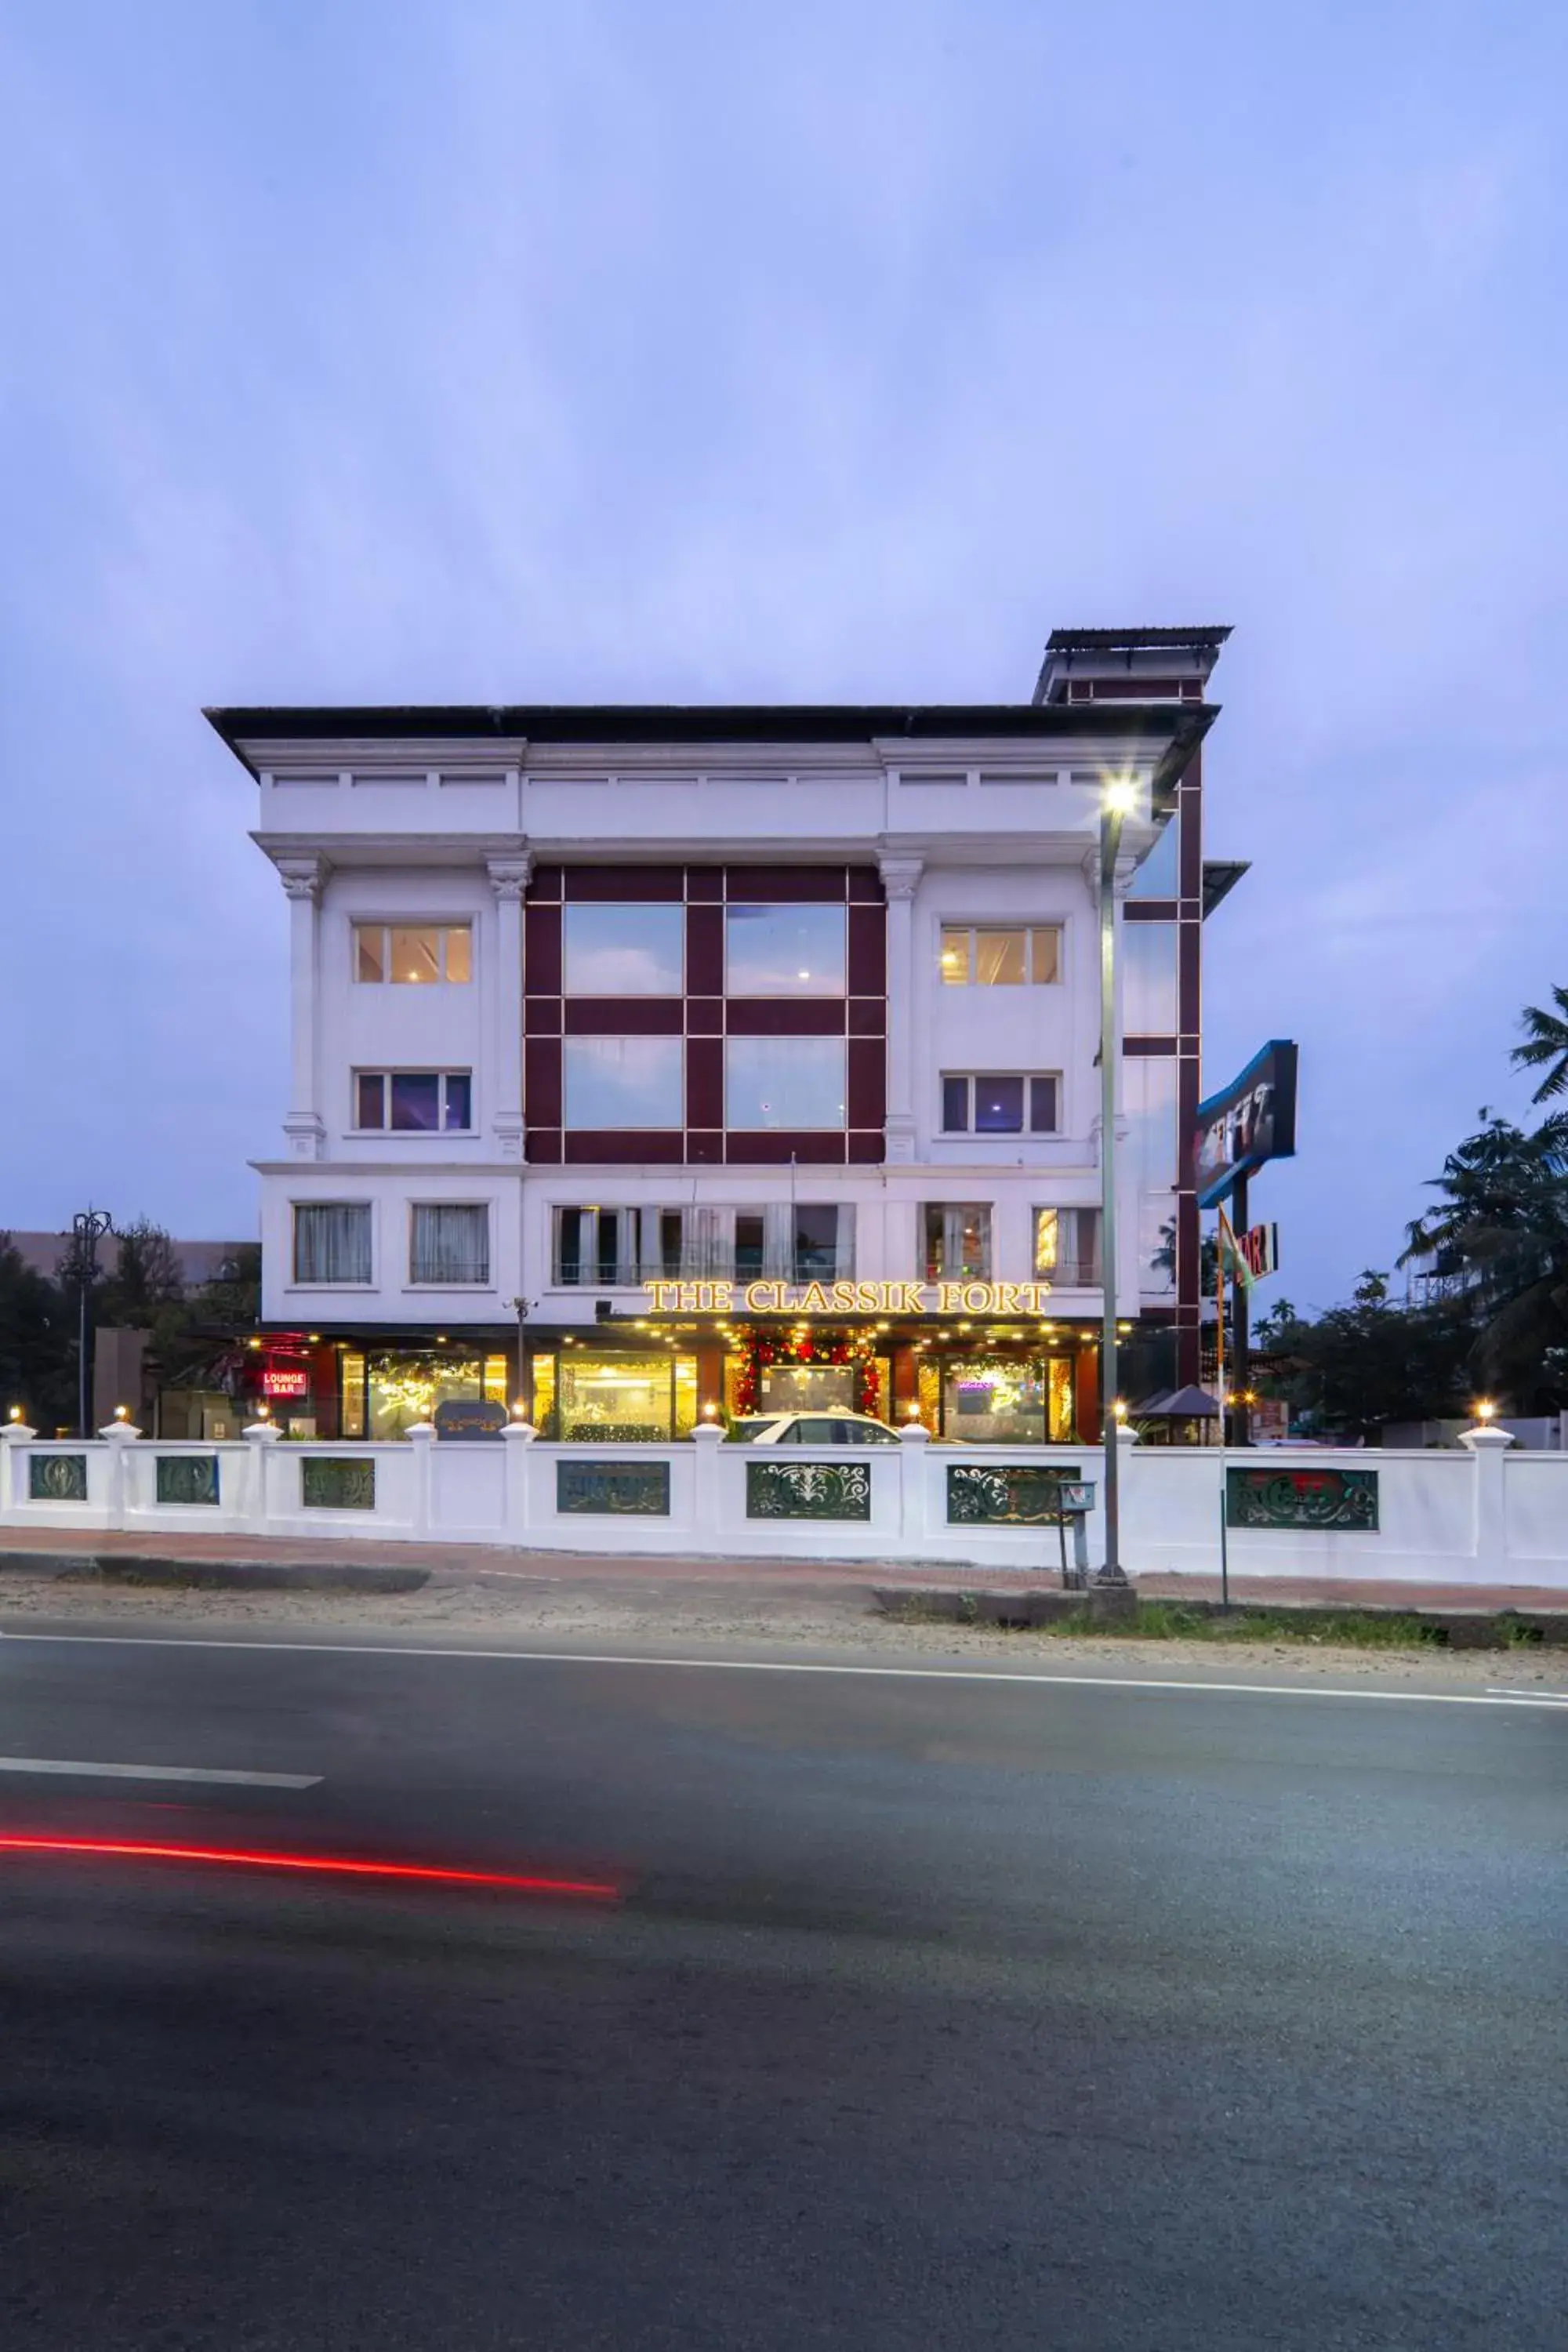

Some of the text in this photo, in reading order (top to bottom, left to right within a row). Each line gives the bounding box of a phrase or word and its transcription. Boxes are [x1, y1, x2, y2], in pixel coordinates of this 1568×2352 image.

[644, 1279, 1051, 1315] THE CLASSIK FORT
[264, 1374, 303, 1384] LOUNGE
[273, 1384, 295, 1393] BAR
